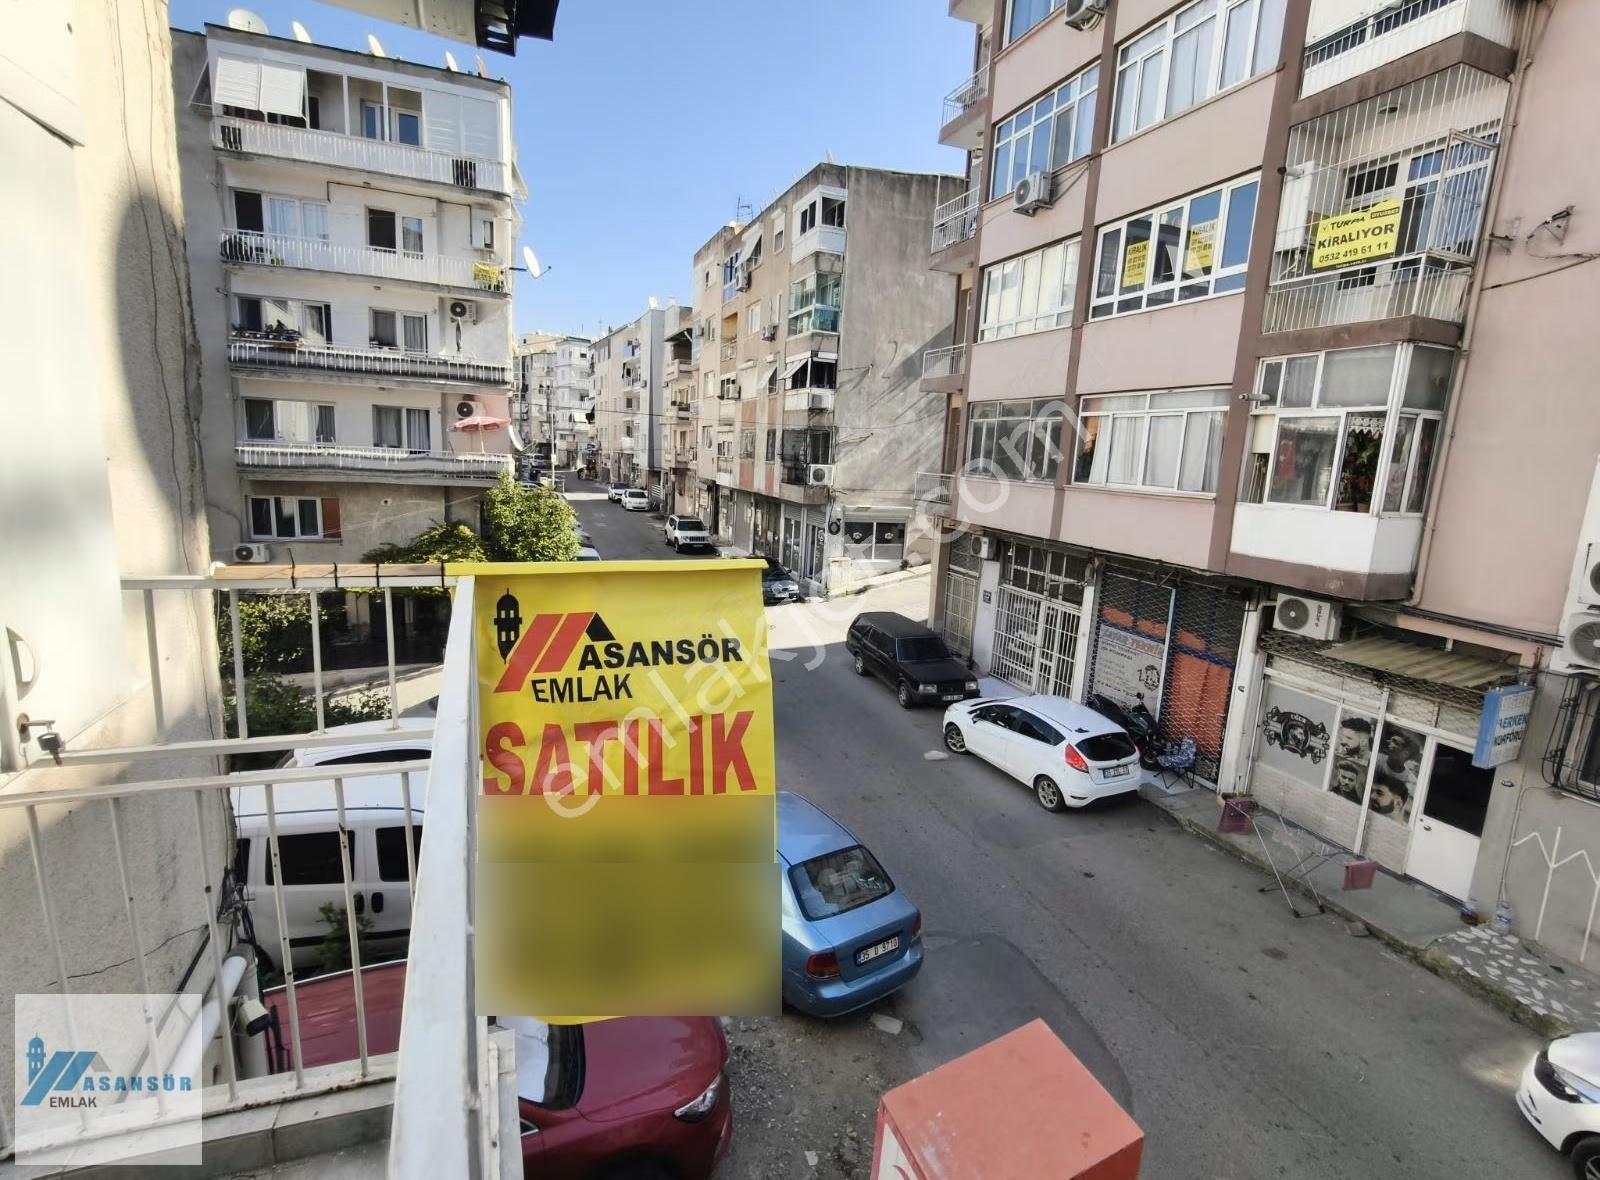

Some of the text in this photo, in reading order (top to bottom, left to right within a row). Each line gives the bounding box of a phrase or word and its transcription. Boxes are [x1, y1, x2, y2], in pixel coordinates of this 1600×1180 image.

[1317, 223, 1395, 250] KİRALIYOR
[1319, 252, 1340, 263] 0532
[1342, 247, 1358, 258] 419
[1376, 241, 1389, 251] 11
[577, 633, 743, 671] ASANSÖR
[531, 673, 633, 704] EMLAK
[484, 710, 758, 796] SATILIK
